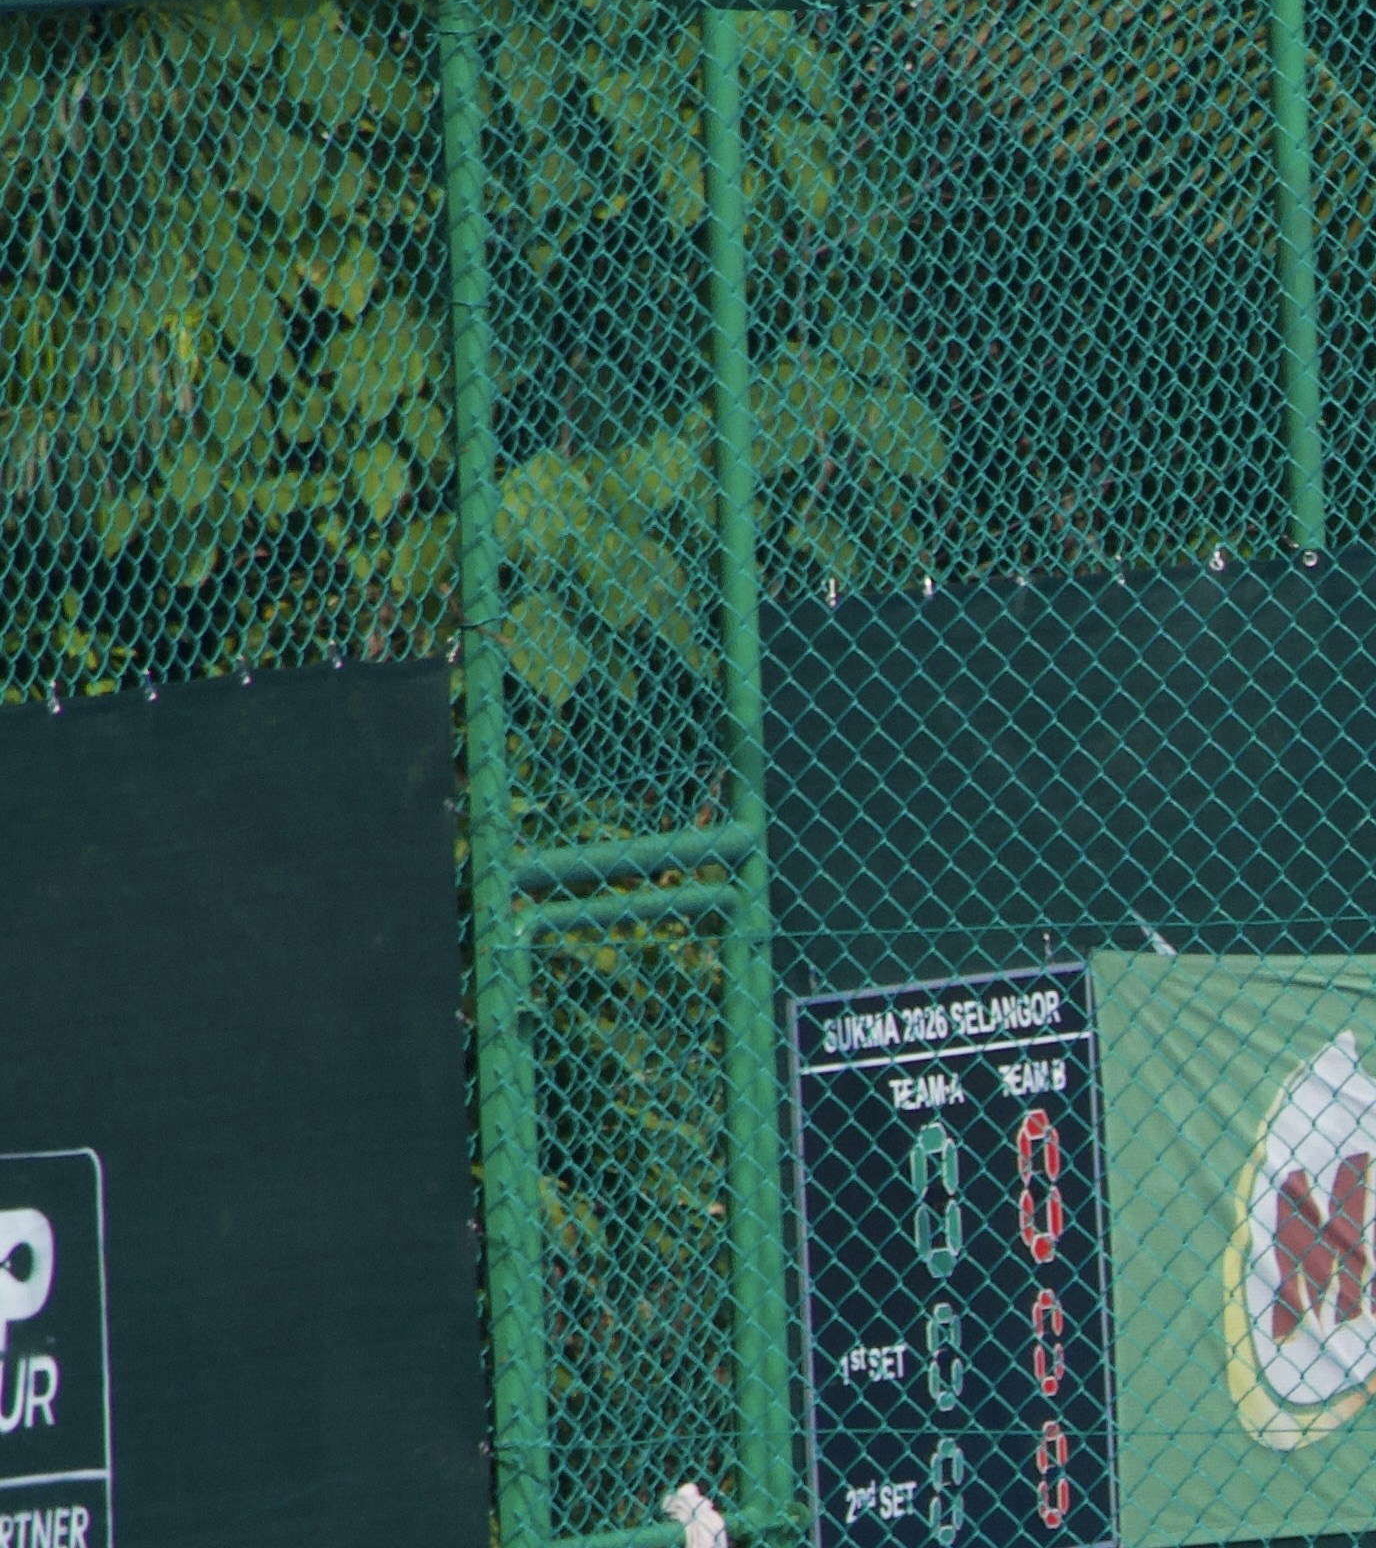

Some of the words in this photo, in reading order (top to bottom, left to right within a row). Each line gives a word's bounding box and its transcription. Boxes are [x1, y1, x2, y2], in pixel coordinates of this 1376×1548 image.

[823, 1011, 900, 1054] SUKMA
[902, 1004, 949, 1043] 2026
[950, 990, 1062, 1036] SELANGOR
[868, 1342, 909, 1382] SET
[845, 1479, 877, 1524] 2nd
[879, 1480, 919, 1521] SET
